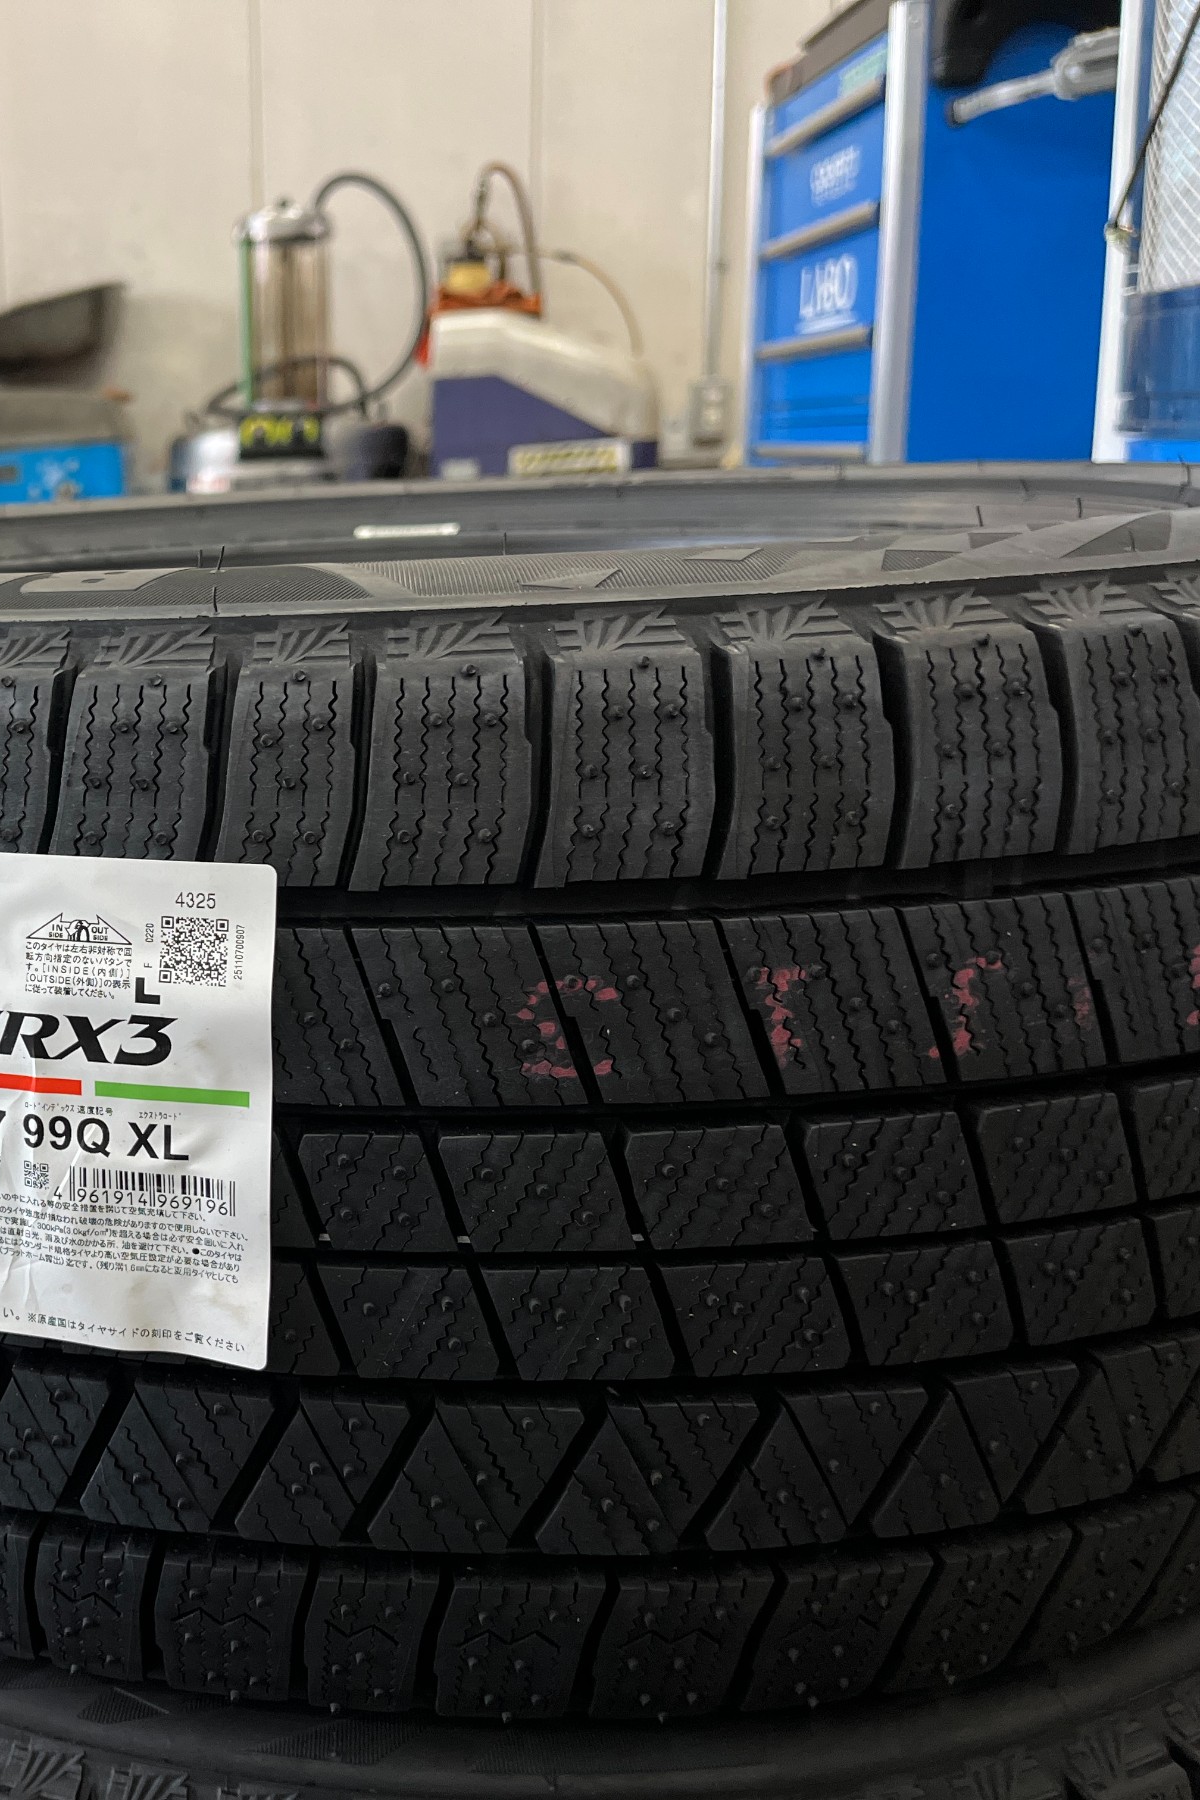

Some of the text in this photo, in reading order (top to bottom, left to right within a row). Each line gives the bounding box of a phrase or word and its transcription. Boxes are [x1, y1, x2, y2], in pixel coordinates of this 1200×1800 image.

[175, 892, 216, 909] 4325
[145, 923, 154, 943] 0220
[26, 942, 132, 957] このタイヤは左右非対称で回
[135, 977, 161, 1005] L
[22, 1113, 112, 1159] 99Q
[127, 1121, 190, 1162] XL
